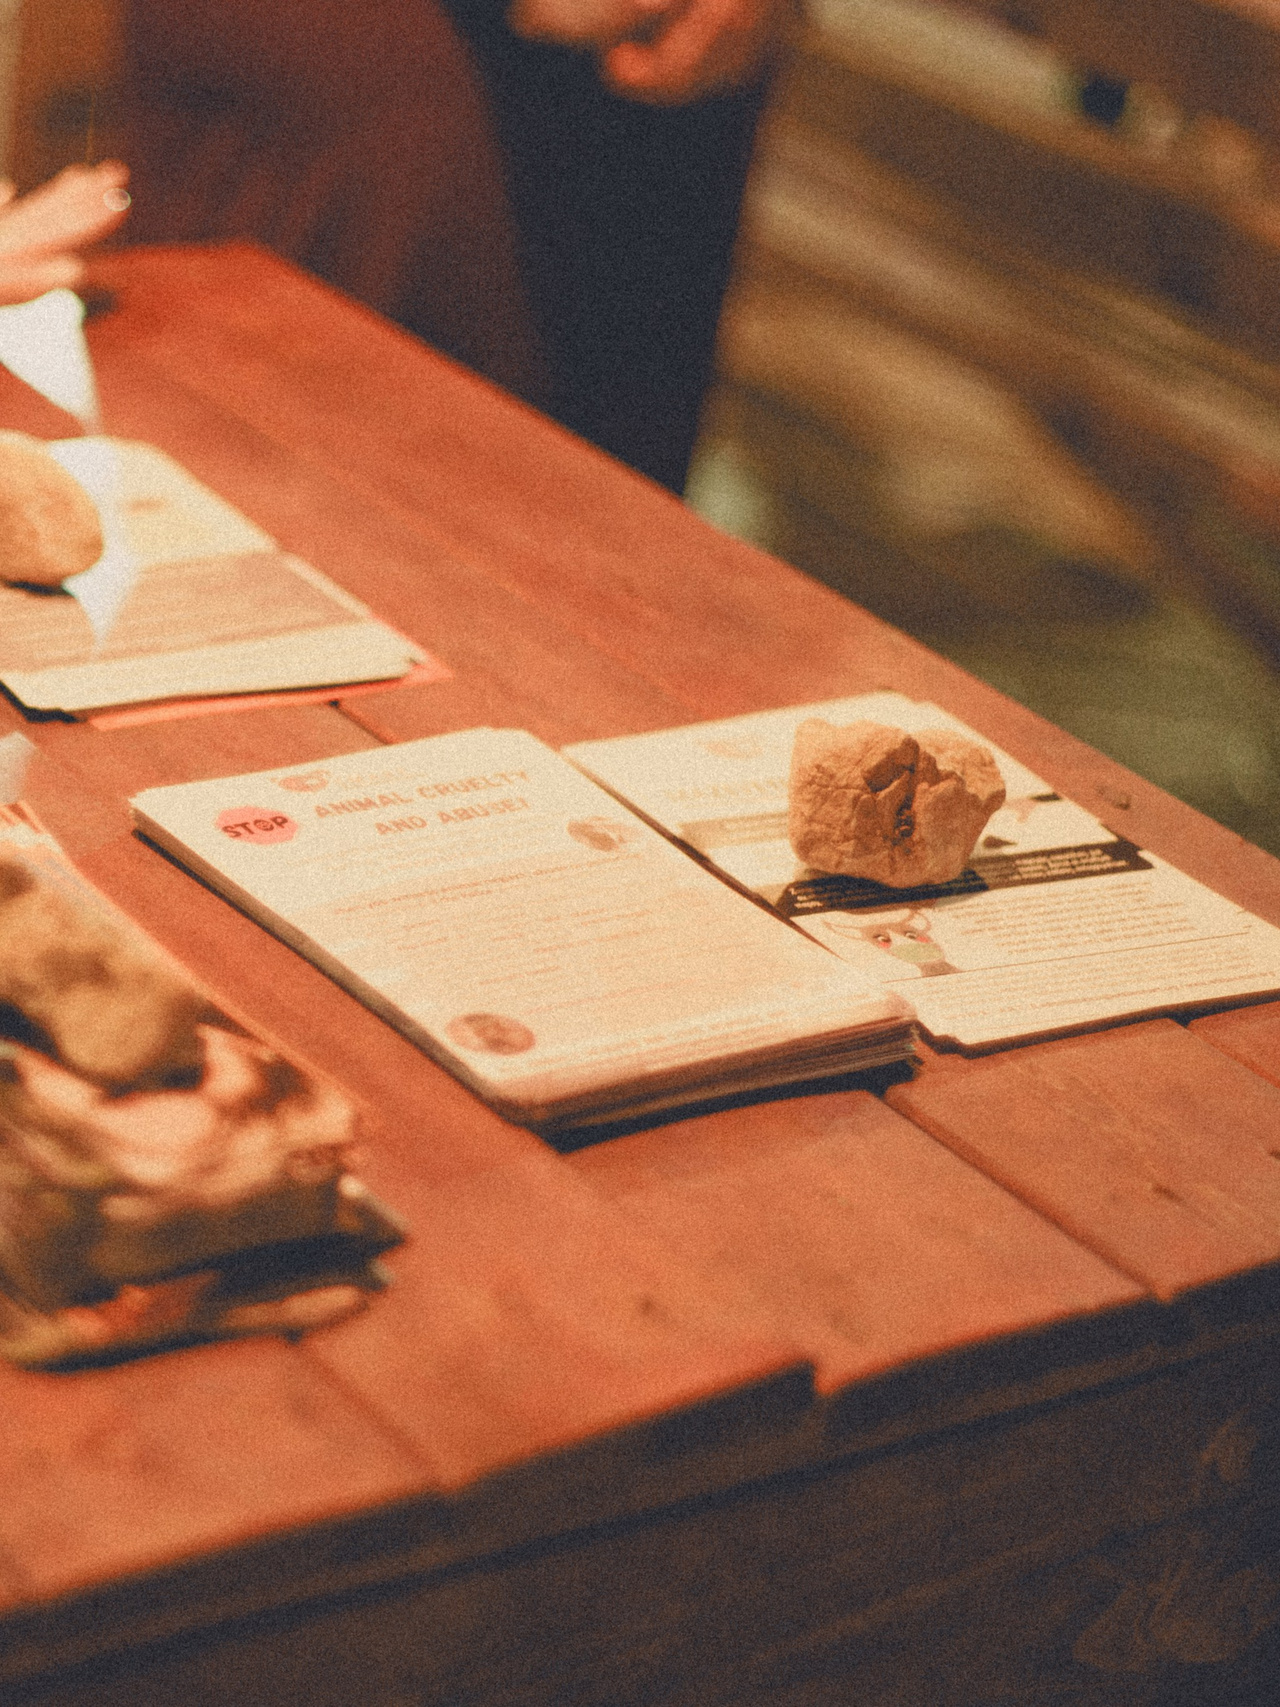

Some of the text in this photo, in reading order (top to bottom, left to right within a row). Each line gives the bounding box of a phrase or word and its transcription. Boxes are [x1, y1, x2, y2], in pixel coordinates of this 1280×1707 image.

[313, 791, 414, 819] ANIMAL
[417, 769, 530, 801] CRUELTY
[221, 815, 289, 839] STOP
[374, 816, 428, 837] AND
